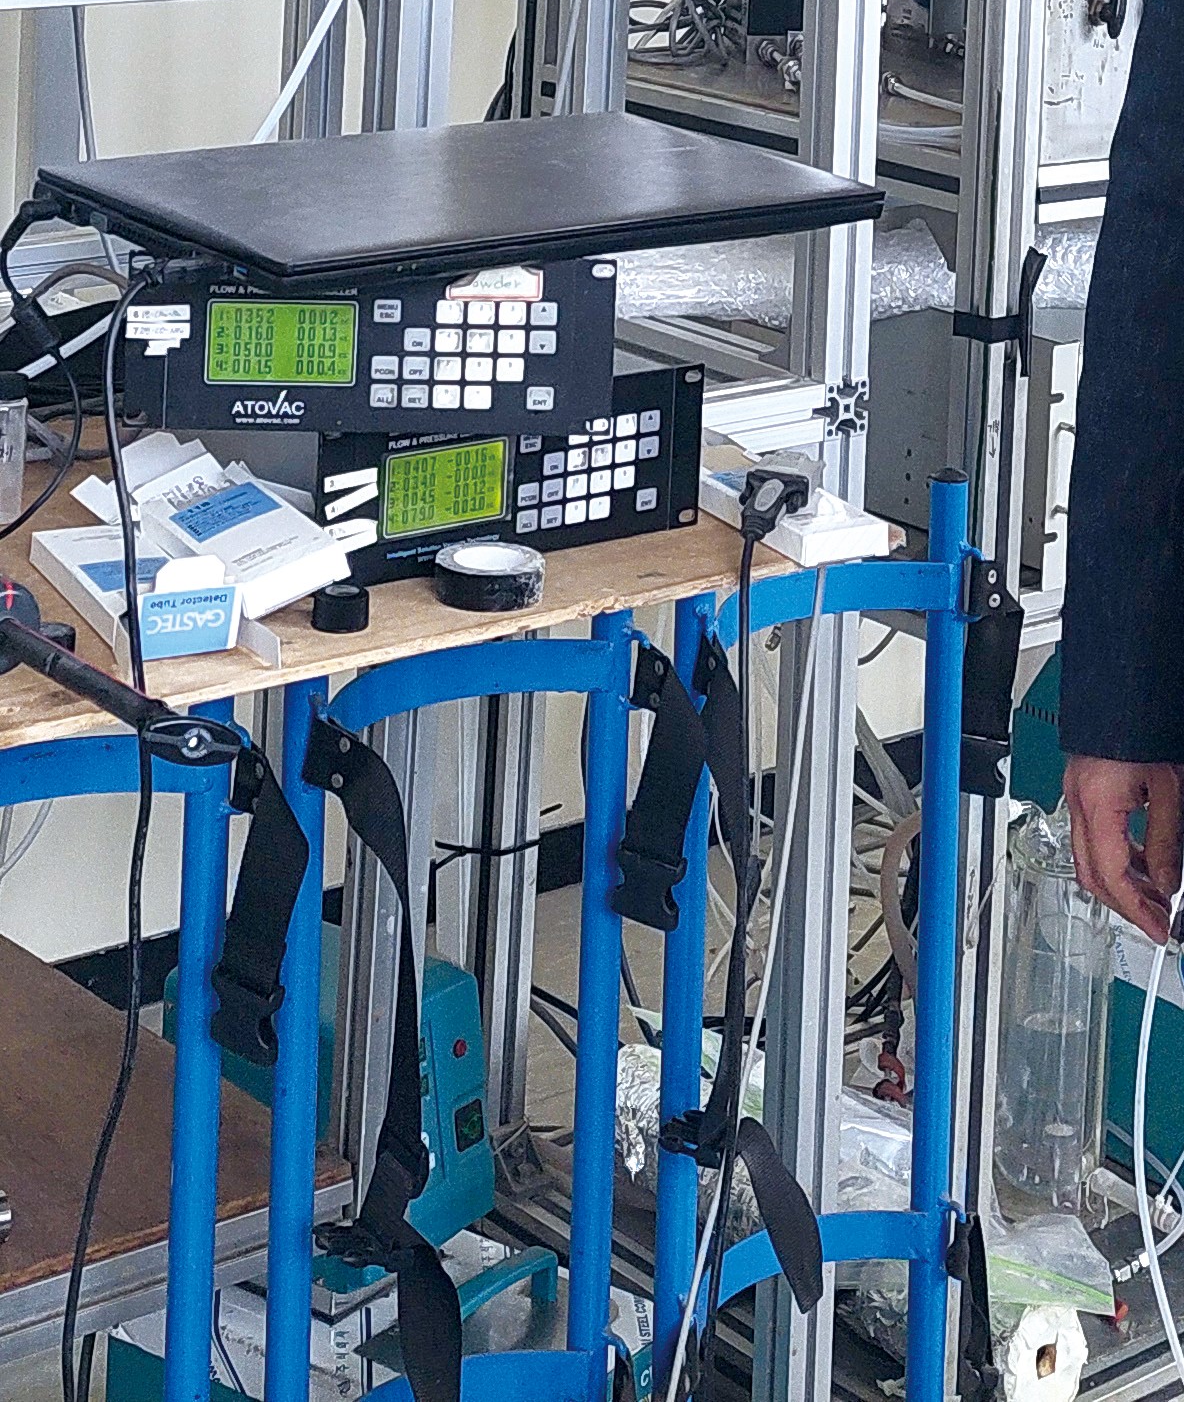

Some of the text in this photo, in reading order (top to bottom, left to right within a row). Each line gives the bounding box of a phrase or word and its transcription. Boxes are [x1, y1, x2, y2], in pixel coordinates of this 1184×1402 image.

[210, 285, 237, 293] FLOW
[472, 272, 522, 289] owder
[234, 307, 275, 325] 0352
[298, 308, 338, 326] 0002
[231, 390, 305, 416] ATOVAC
[150, 593, 228, 610] Detector Tube
[145, 609, 226, 635] GASTEC
[637, 1314, 652, 1338] STEEL
